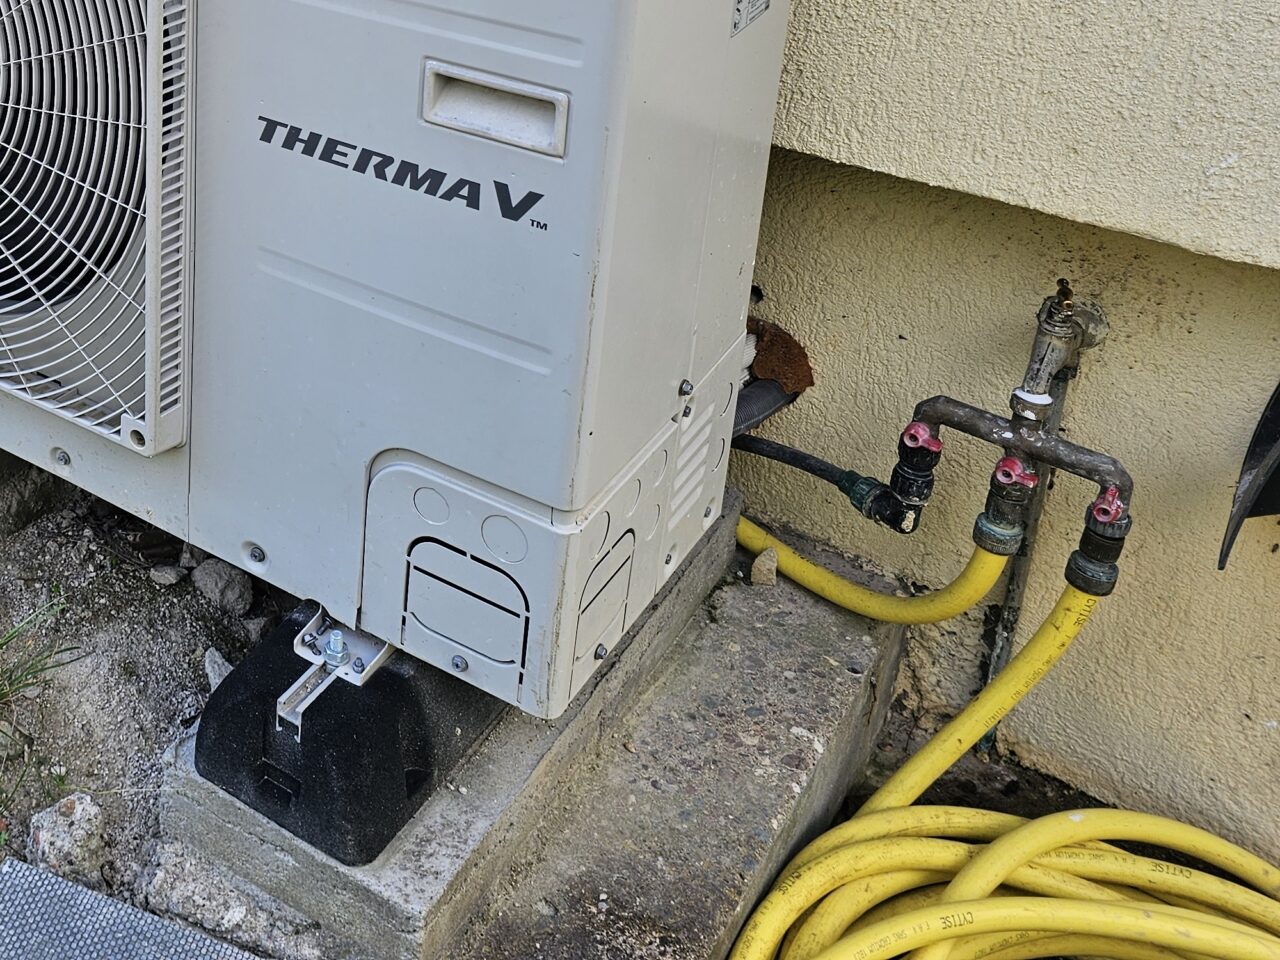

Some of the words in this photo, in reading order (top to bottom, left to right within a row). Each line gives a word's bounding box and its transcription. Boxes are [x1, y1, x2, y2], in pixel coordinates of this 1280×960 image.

[1073, 598, 1097, 627] CYTISE
[1151, 861, 1193, 879] CYTISE
[939, 911, 974, 930] CYTISE
